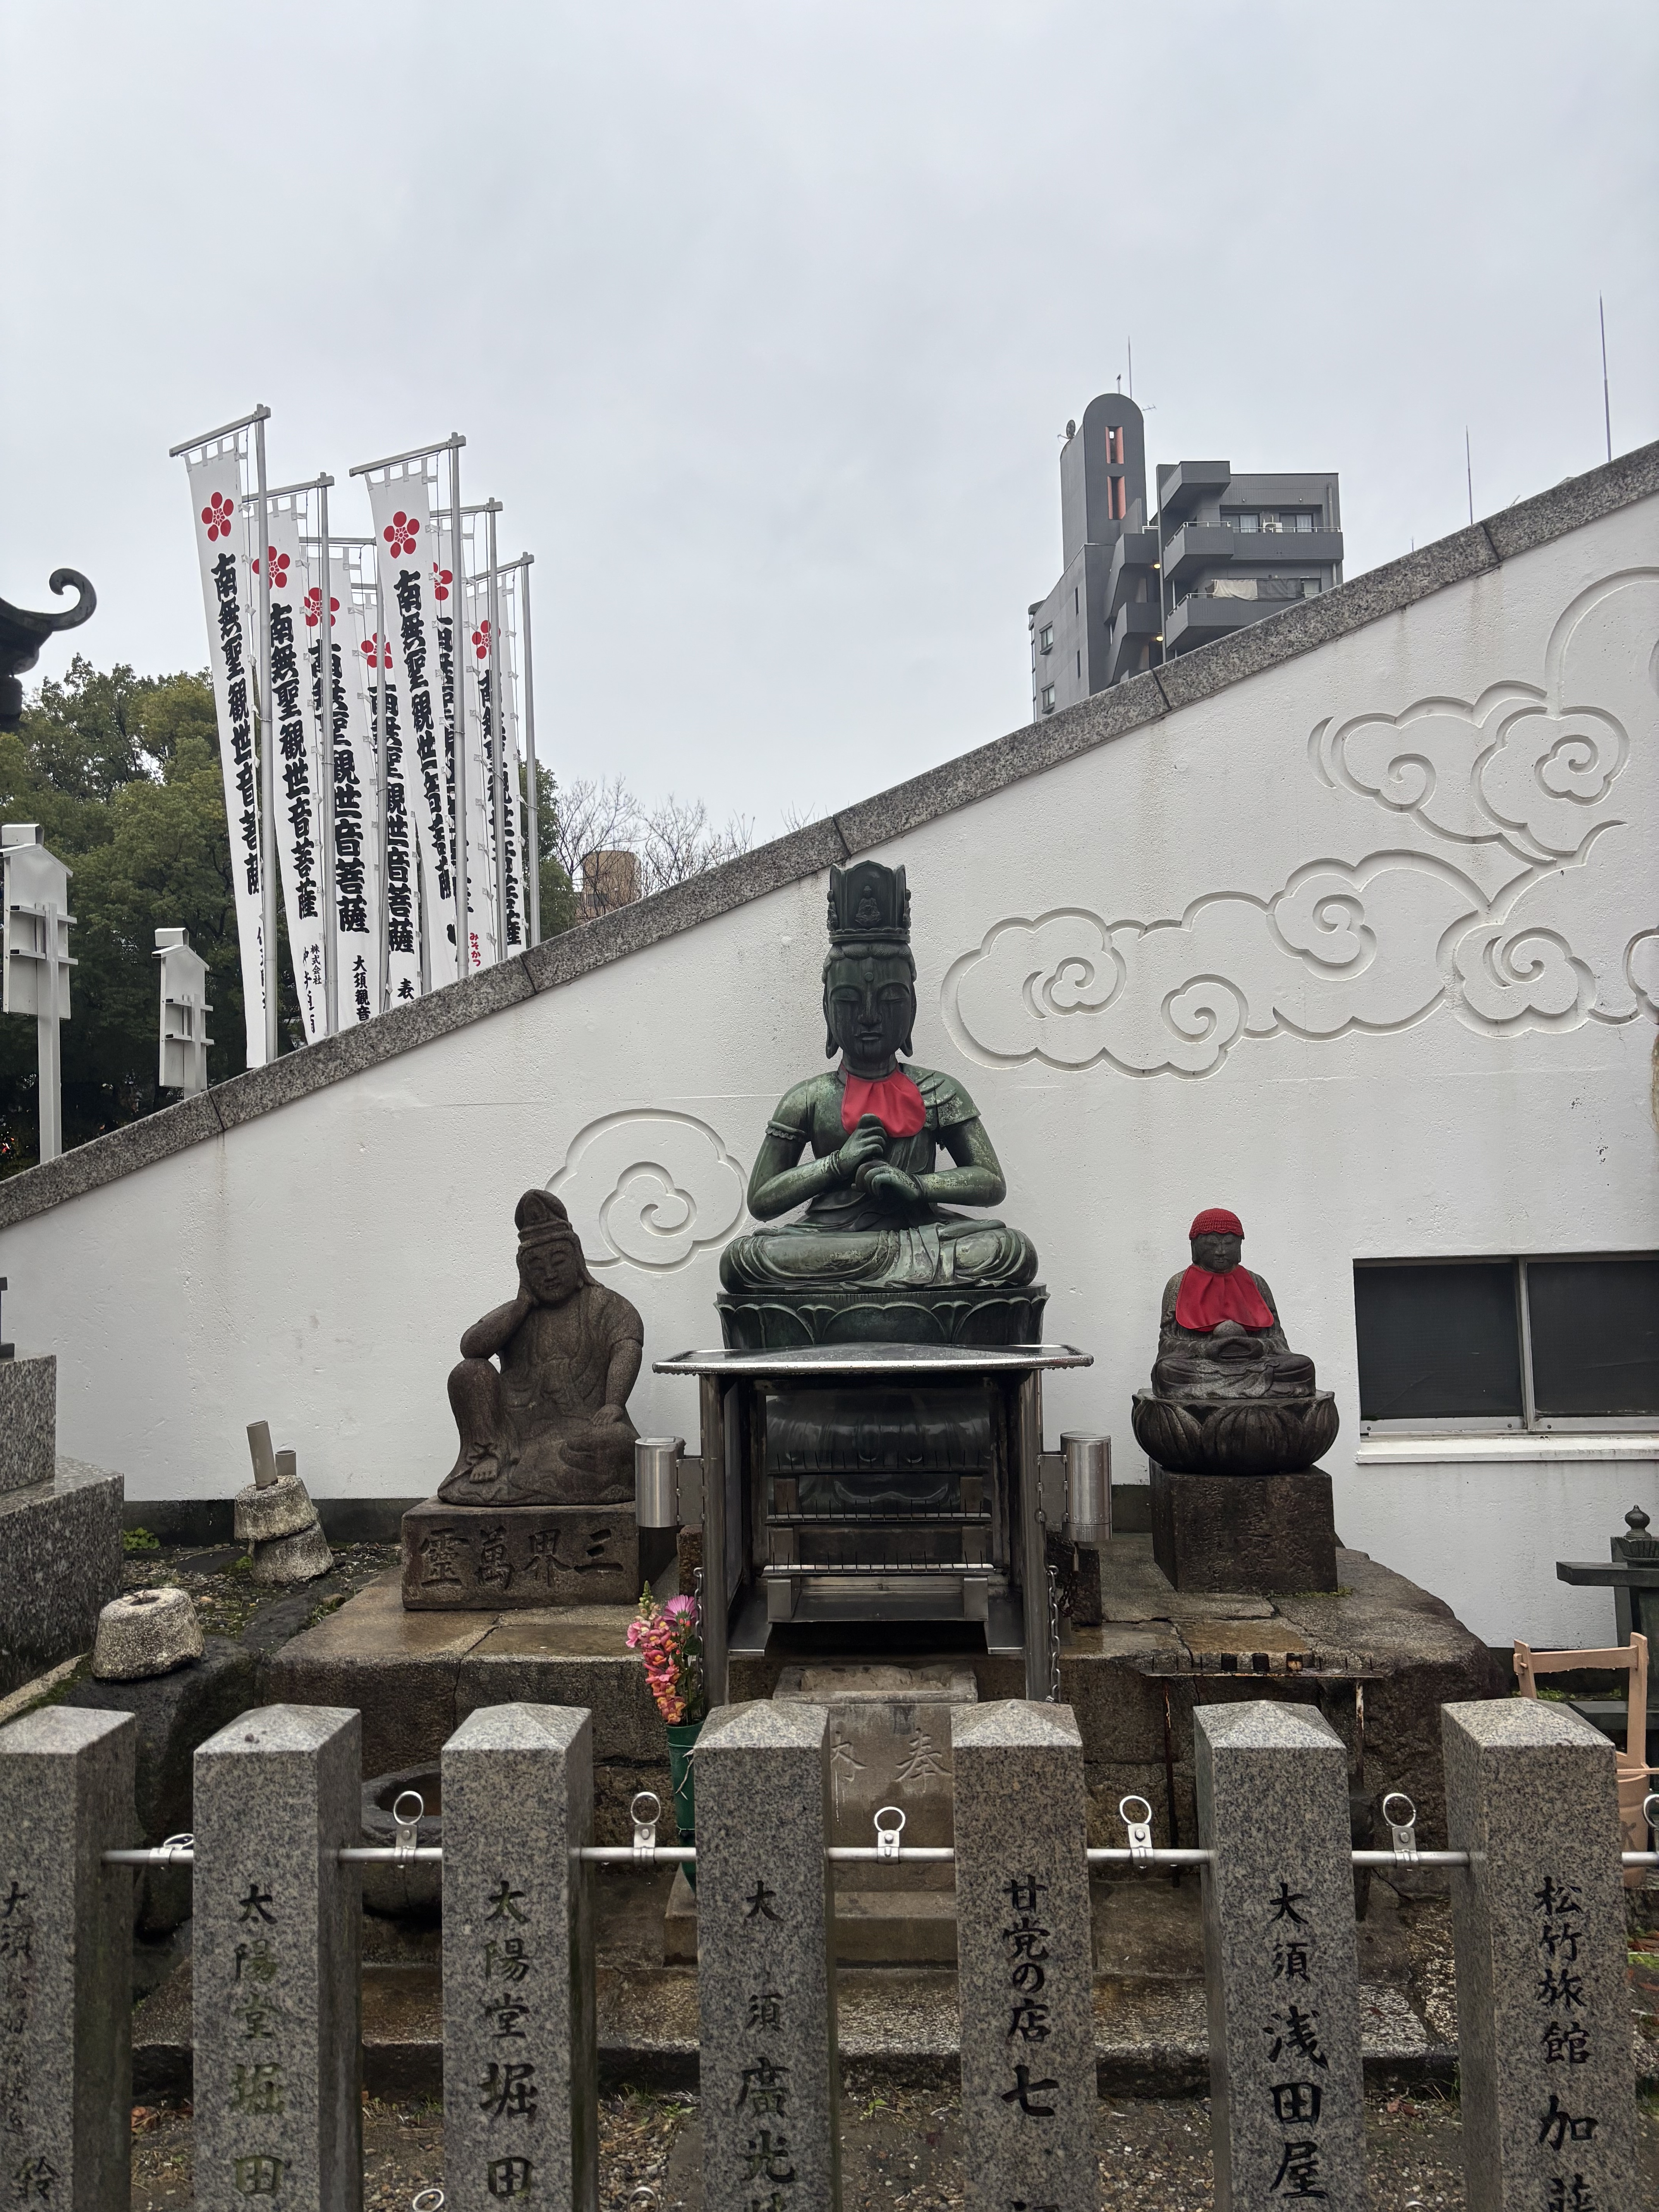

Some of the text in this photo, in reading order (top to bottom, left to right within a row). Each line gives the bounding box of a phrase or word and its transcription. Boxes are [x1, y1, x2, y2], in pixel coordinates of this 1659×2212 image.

[270, 603, 318, 920] 南無聖観世音菩薩
[310, 944, 322, 985] 株式会社
[470, 933, 481, 967] みそかつ
[352, 955, 371, 1021] 大須観音
[1001, 1874, 1060, 2212] 甘党の店七
